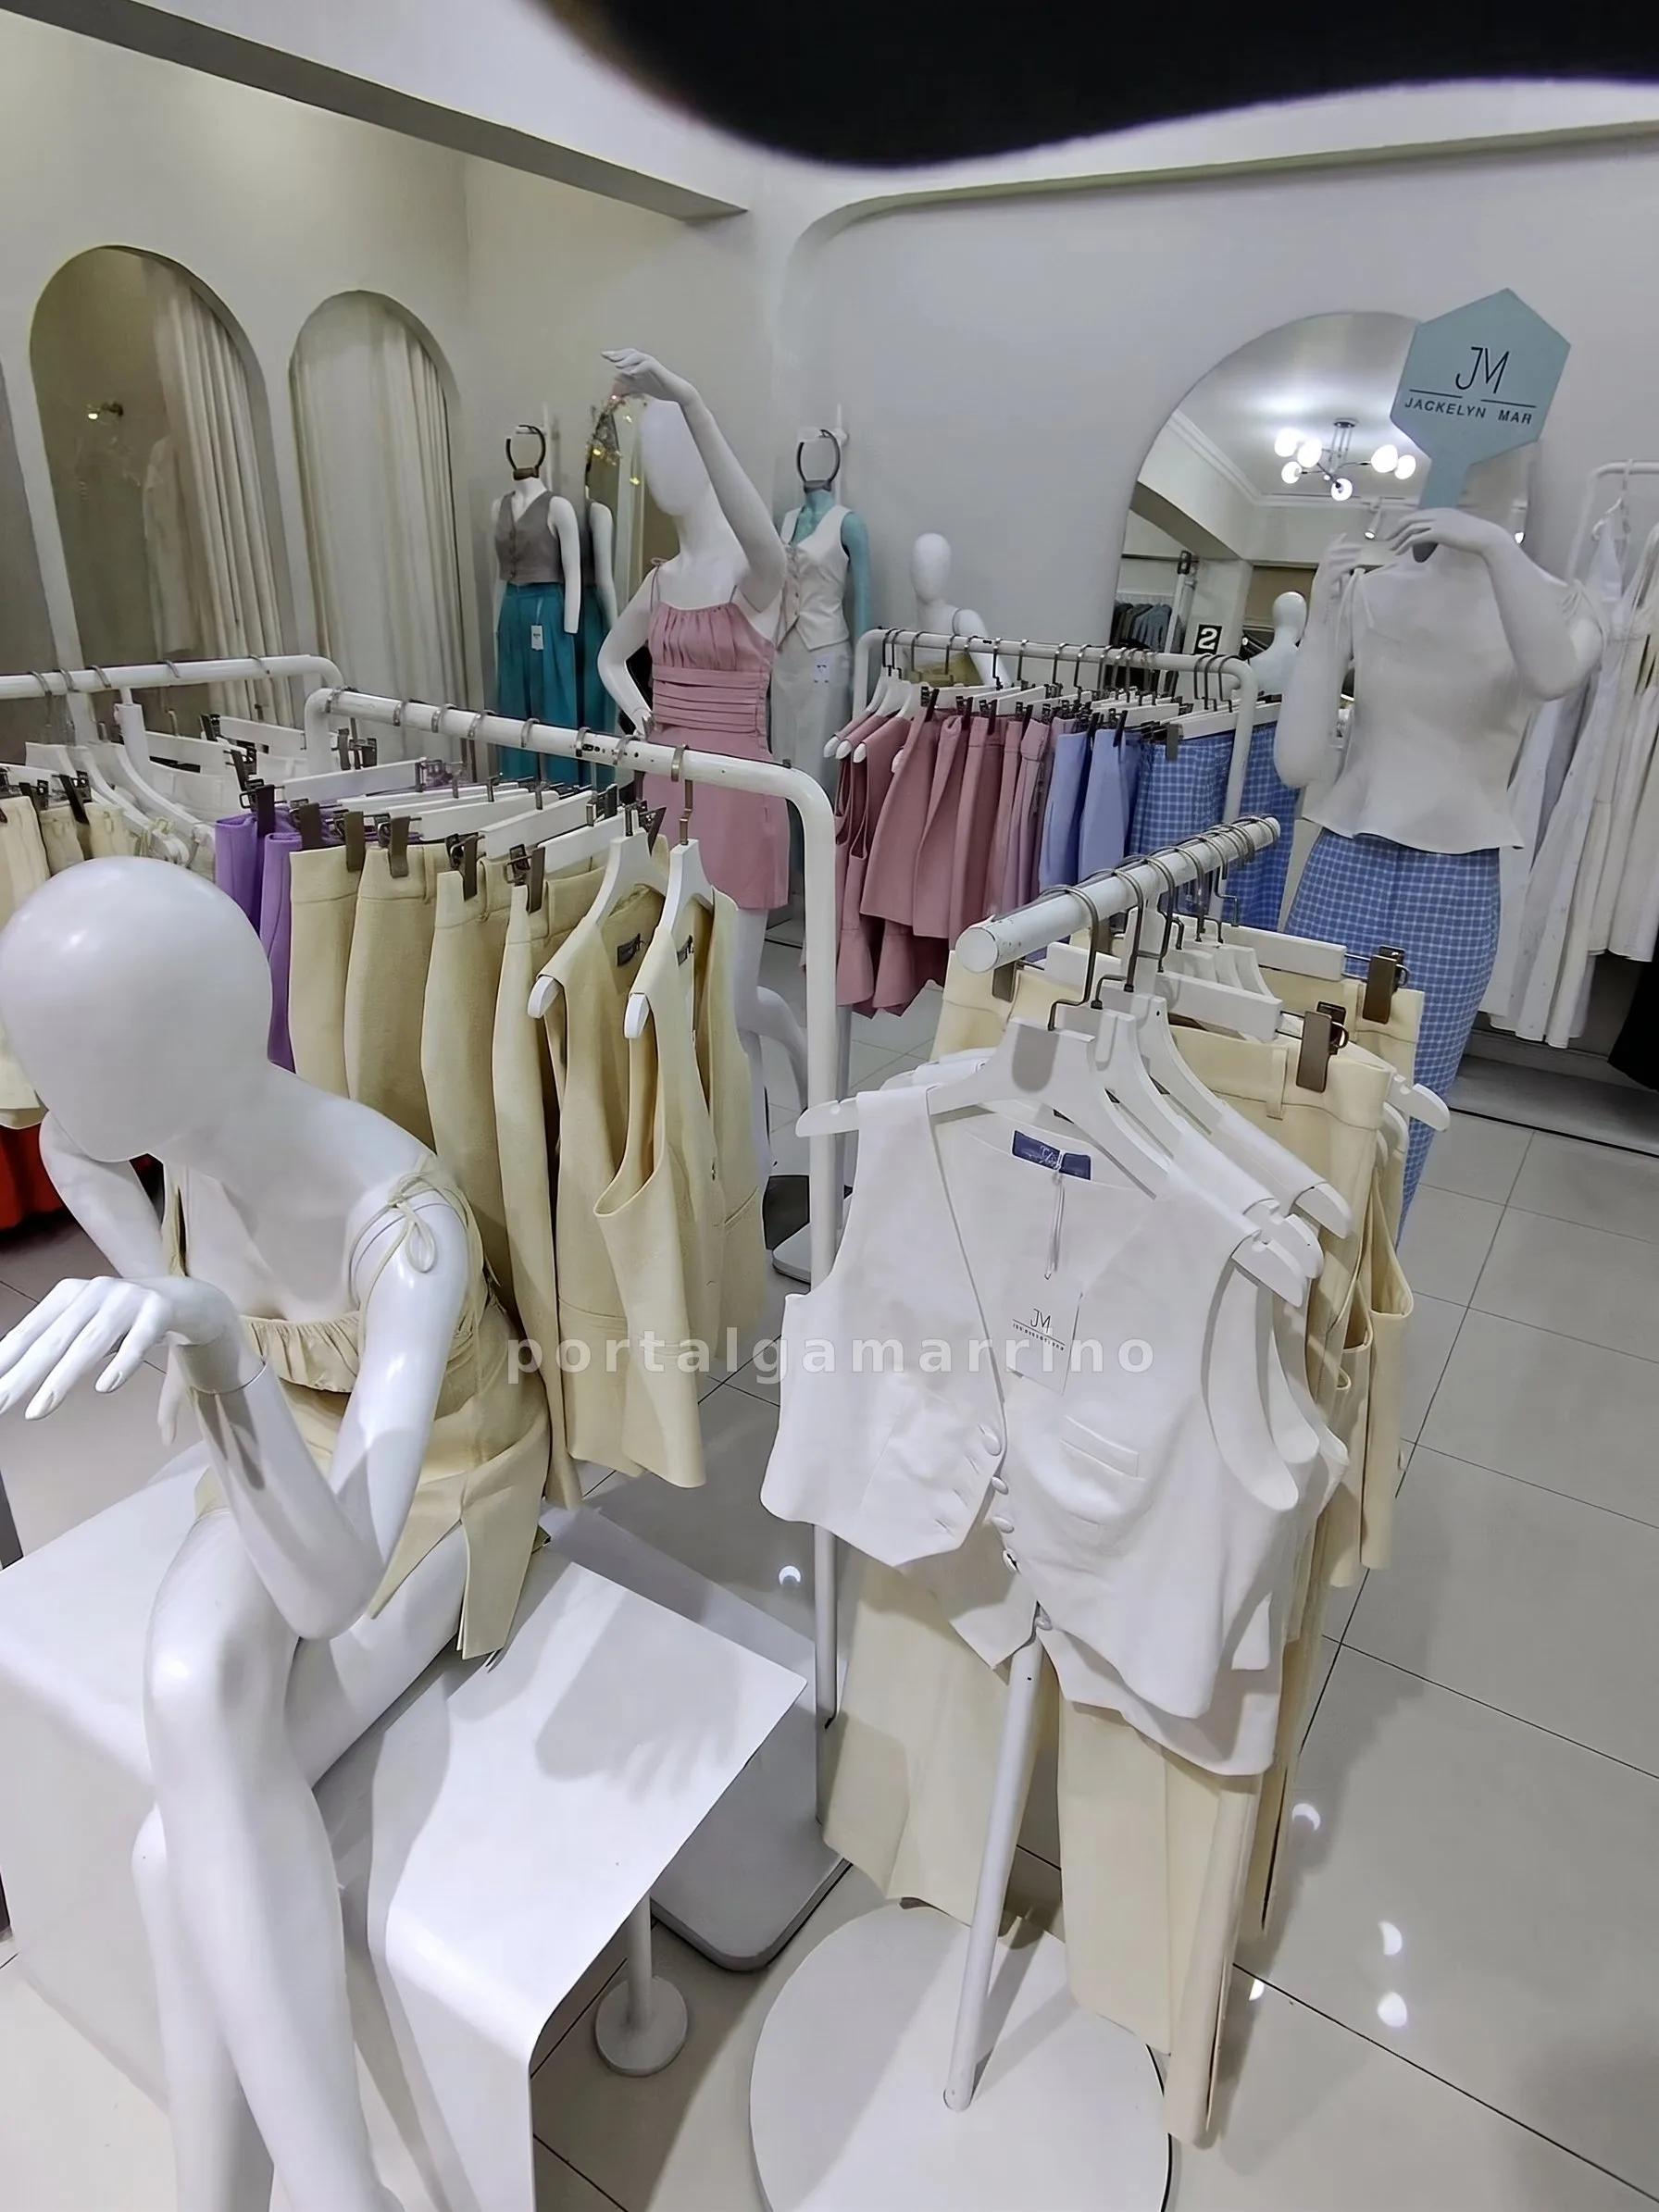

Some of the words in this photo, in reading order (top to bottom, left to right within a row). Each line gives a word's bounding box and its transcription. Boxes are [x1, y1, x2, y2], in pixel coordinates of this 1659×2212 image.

[1454, 345, 1510, 394] JM
[1404, 397, 1487, 418] JACKELYN
[1497, 409, 1533, 425] MAR
[1029, 1308, 1051, 1334] JM
